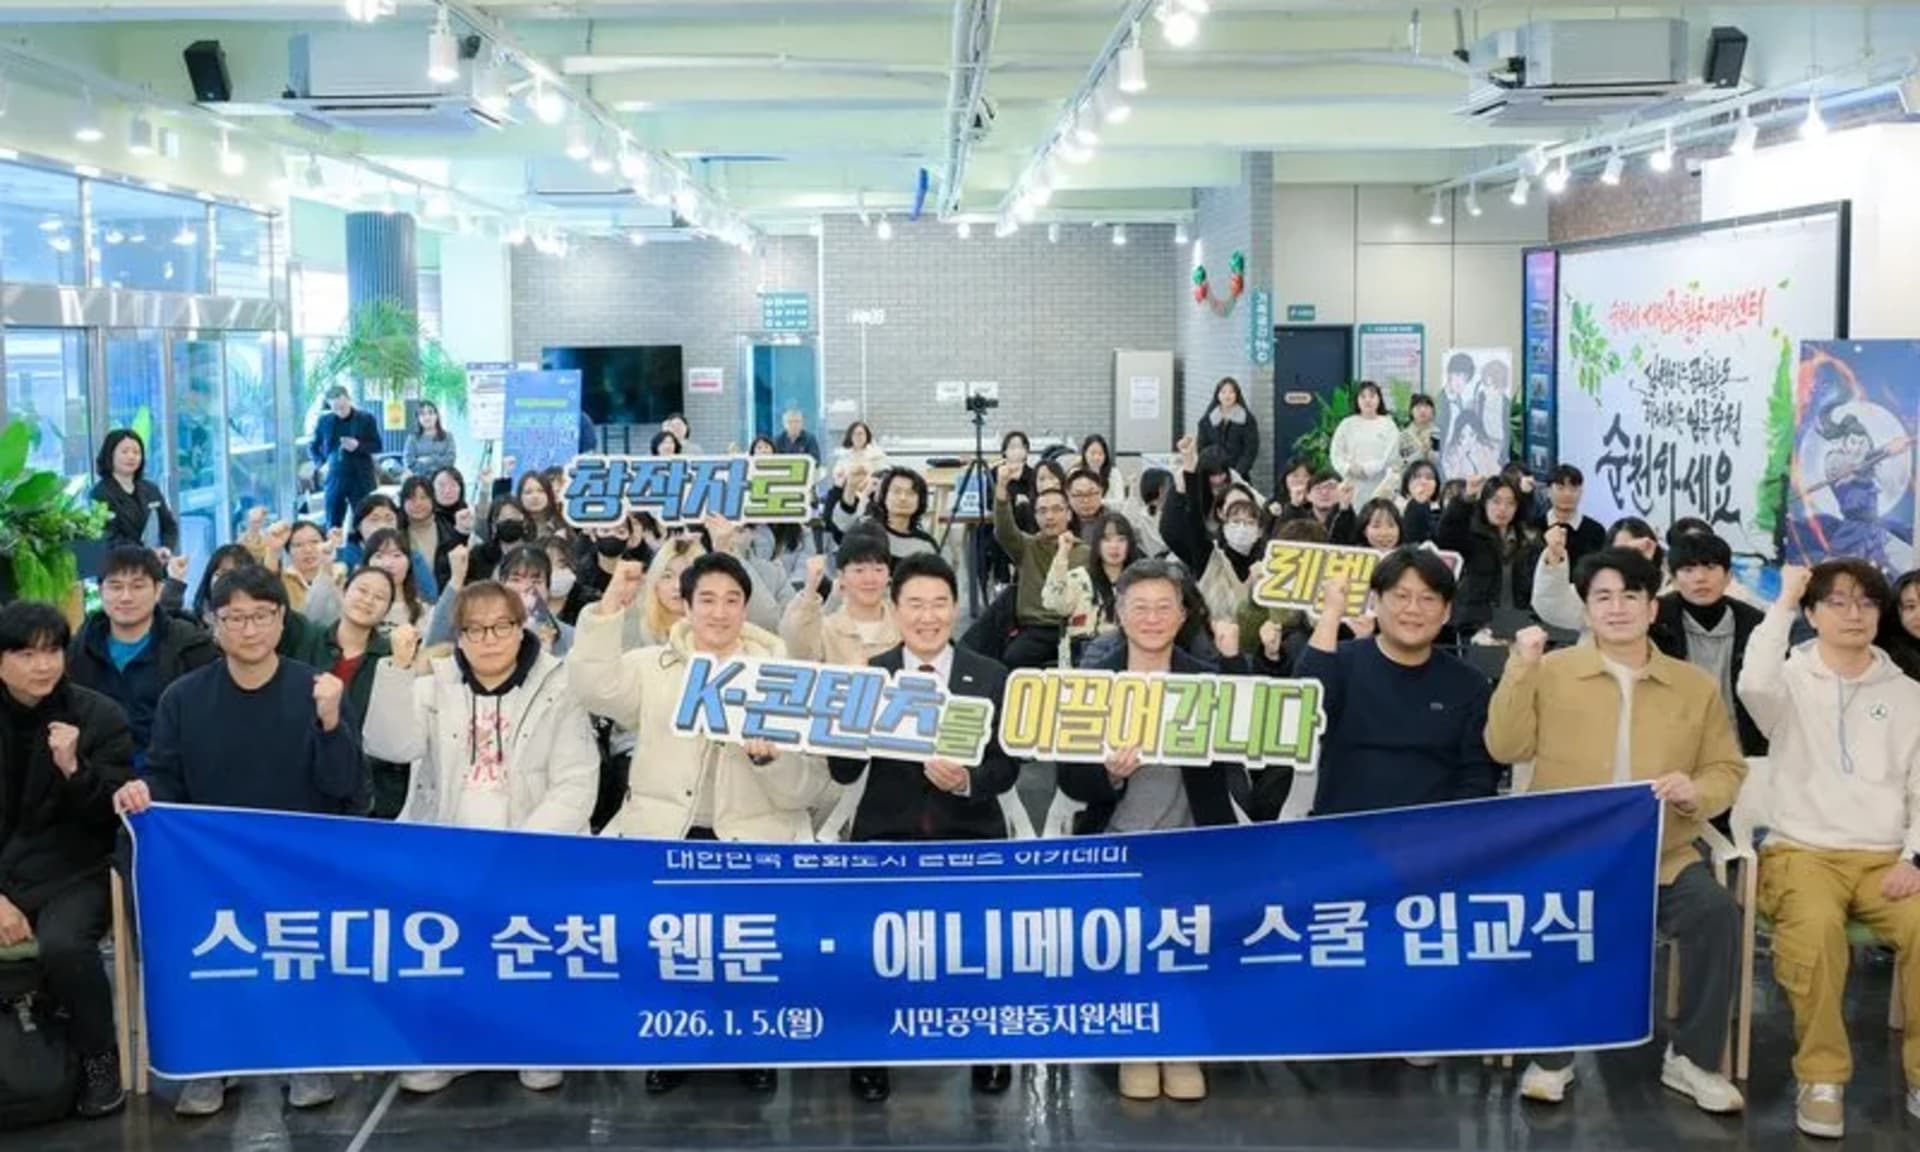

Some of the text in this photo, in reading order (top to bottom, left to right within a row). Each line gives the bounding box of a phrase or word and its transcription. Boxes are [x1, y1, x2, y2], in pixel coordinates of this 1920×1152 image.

[565, 457, 810, 521] 창작자로
[1596, 413, 1741, 528] 순천하세요
[675, 657, 988, 758] K-콘텐츠를
[1003, 673, 1321, 763] 이끌어갑니다
[190, 909, 464, 983] 스튜디오
[491, 913, 620, 980] 순천
[648, 913, 783, 982] 웹툰
[872, 903, 1211, 981] 애니메이션
[1240, 901, 1369, 966] 스쿨
[1395, 890, 1594, 965] 입교식
[638, 1003, 1160, 1039] 2026. 1. 5.(월) 시민공익활동지원센터
